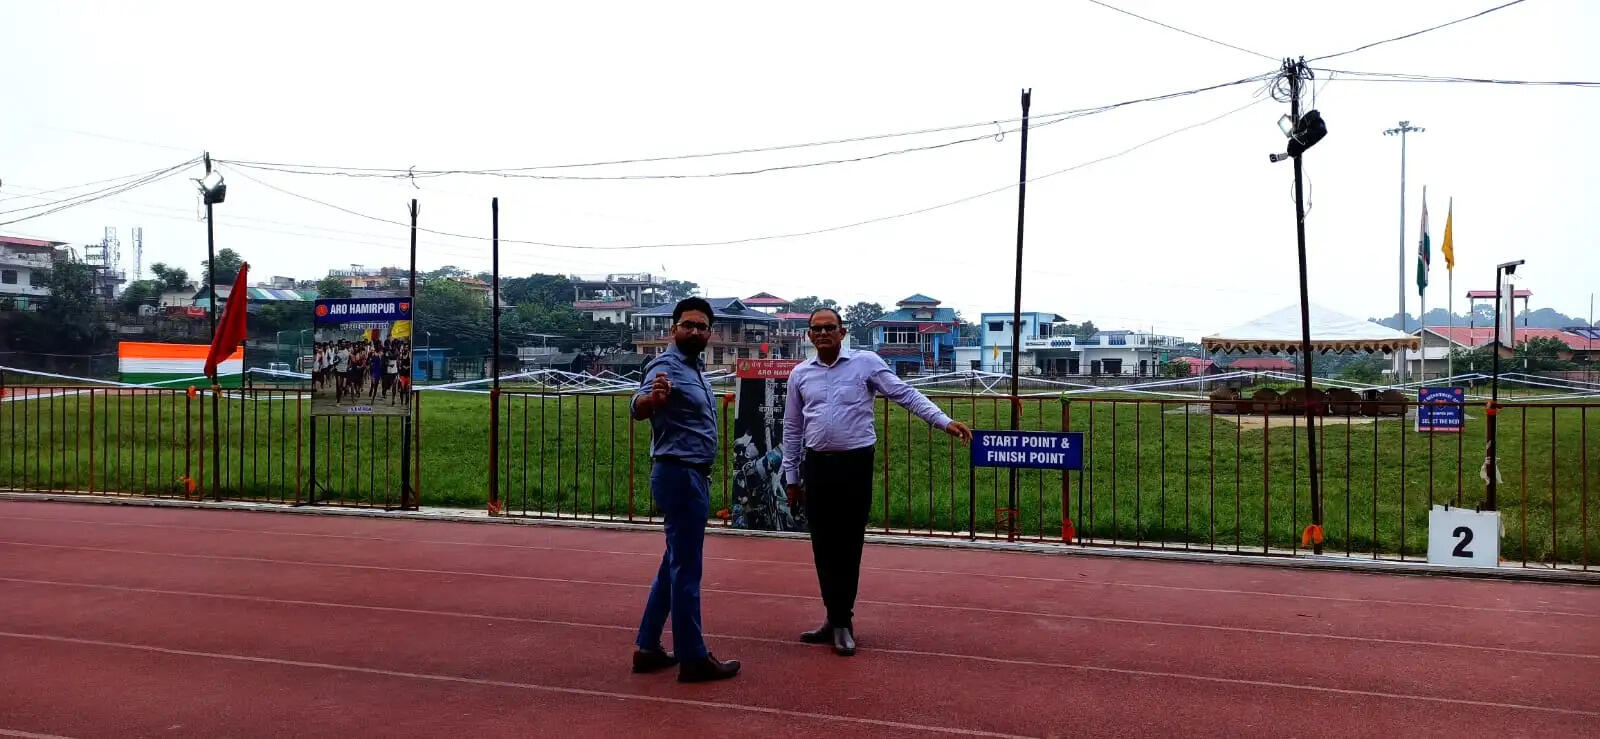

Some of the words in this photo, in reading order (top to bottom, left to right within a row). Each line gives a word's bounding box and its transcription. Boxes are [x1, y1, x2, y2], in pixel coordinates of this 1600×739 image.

[330, 304, 347, 314] ARO
[349, 303, 396, 314] HAMIRPUR
[983, 435, 1018, 447] START
[1022, 436, 1057, 448] POINT
[1061, 438, 1070, 449] &
[987, 450, 1026, 463] FINISH
[1030, 452, 1065, 464] POINT
[1452, 526, 1474, 558] 2
